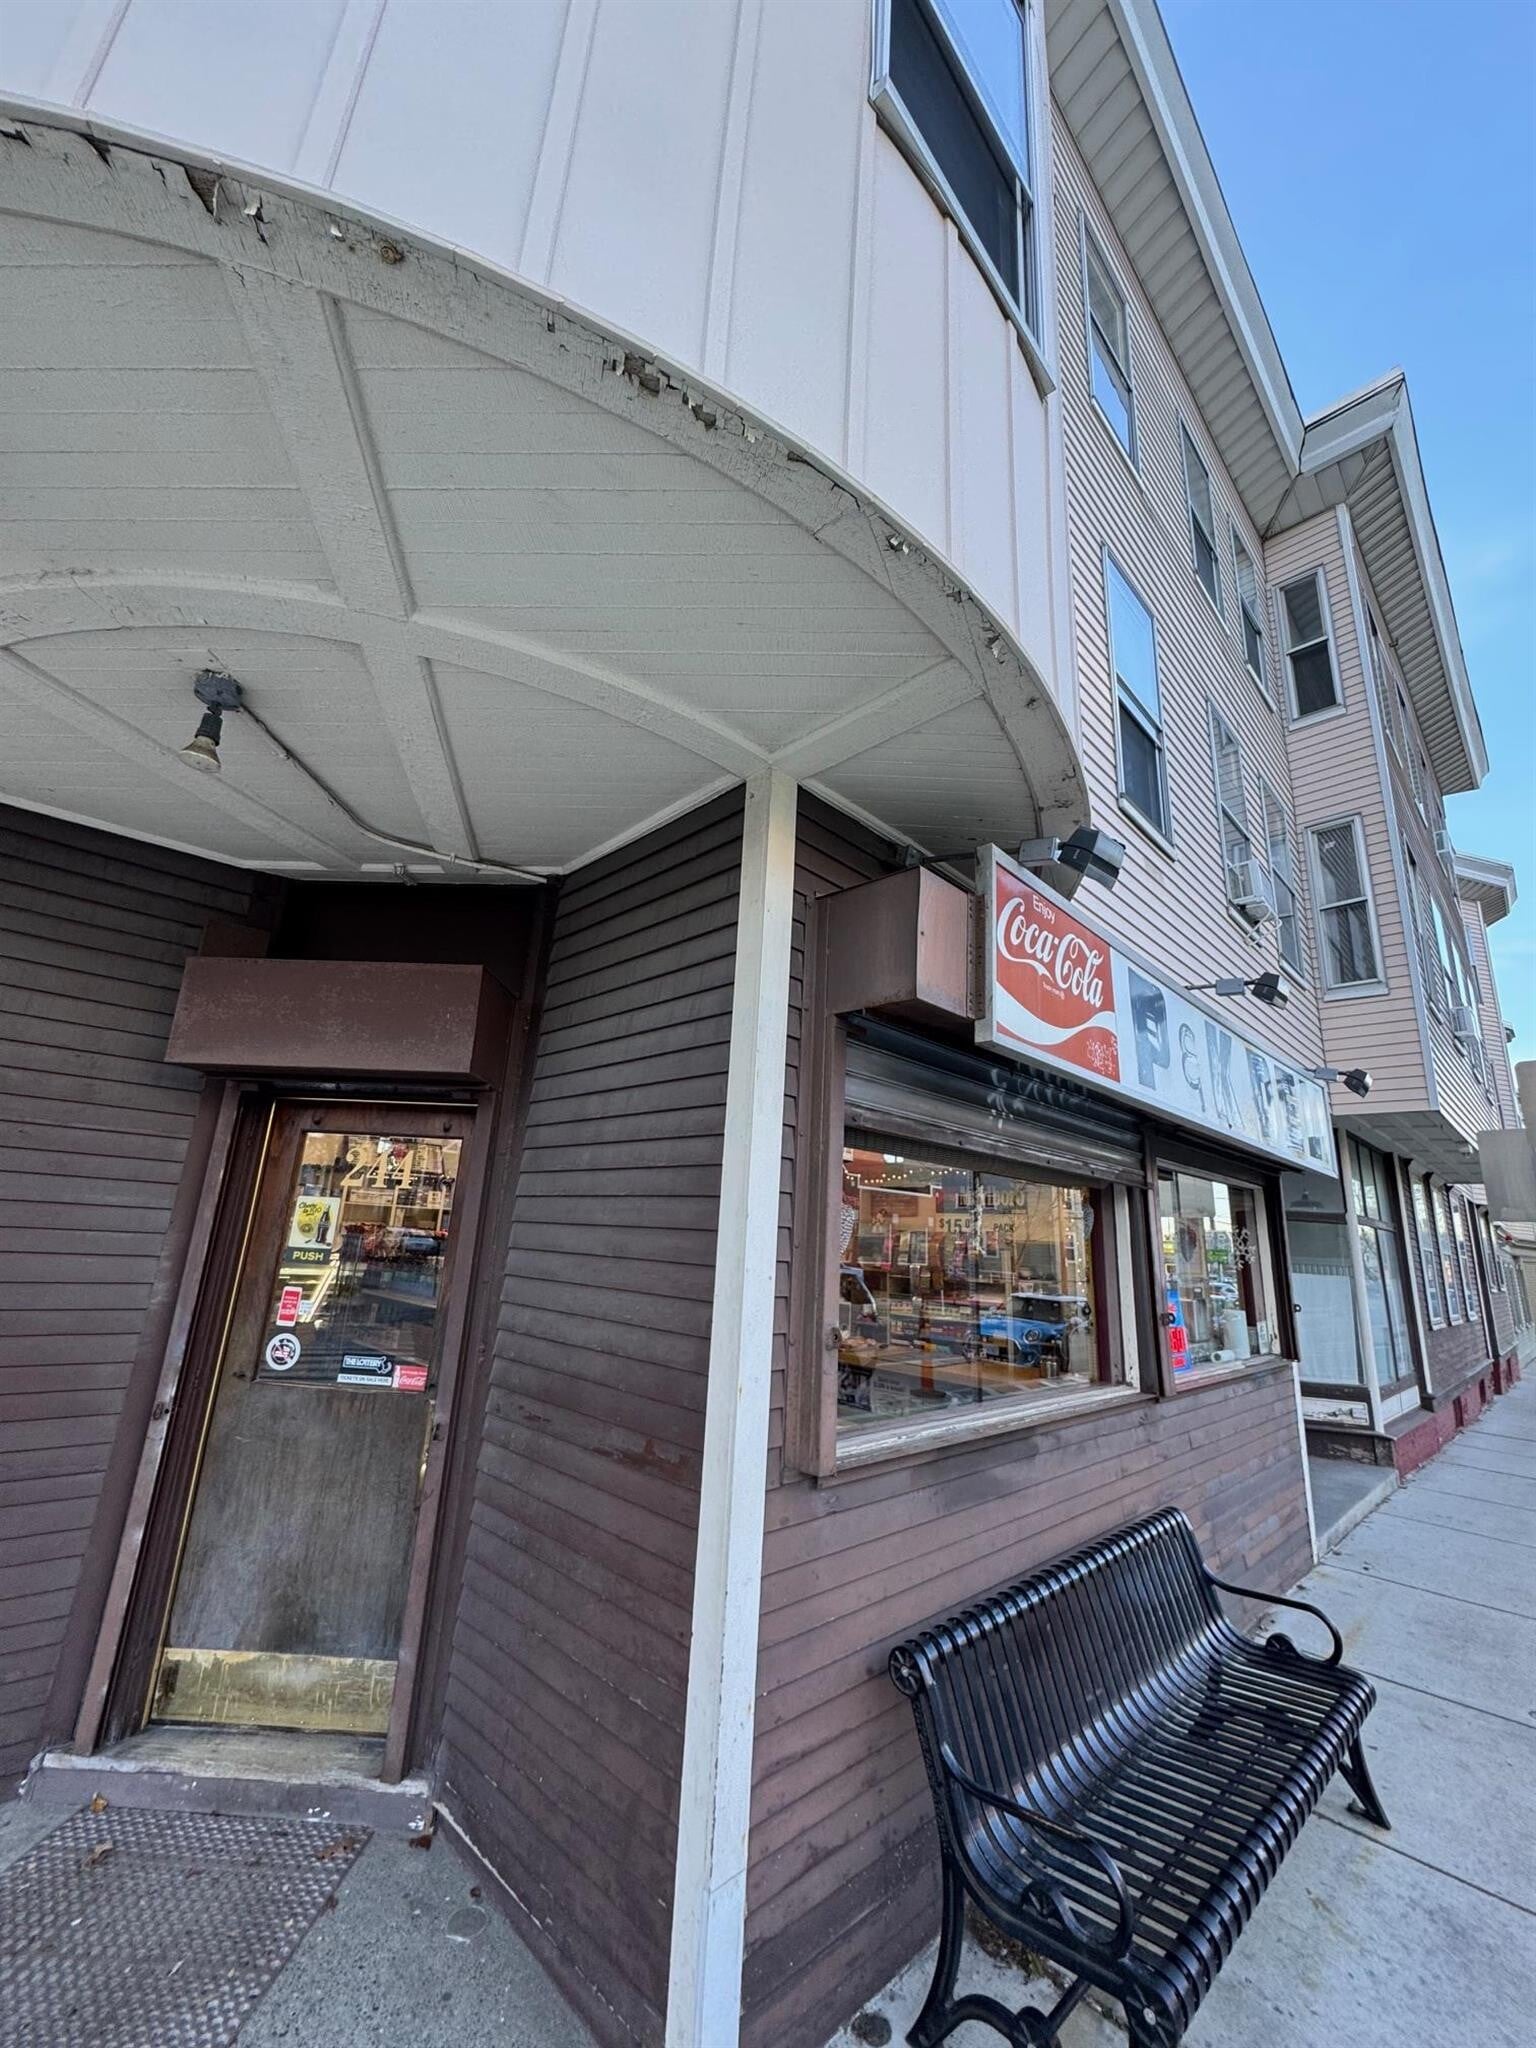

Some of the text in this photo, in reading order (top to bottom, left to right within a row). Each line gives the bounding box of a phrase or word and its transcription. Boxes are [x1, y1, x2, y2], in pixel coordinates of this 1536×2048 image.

[1033, 894, 1057, 924] Enjoy
[997, 896, 1105, 1009] Coca-Cola
[1128, 966, 1171, 1091] P
[340, 1147, 417, 1189] 244
[292, 1250, 324, 1261] PUSH
[356, 1358, 381, 1367] LOTTERY
